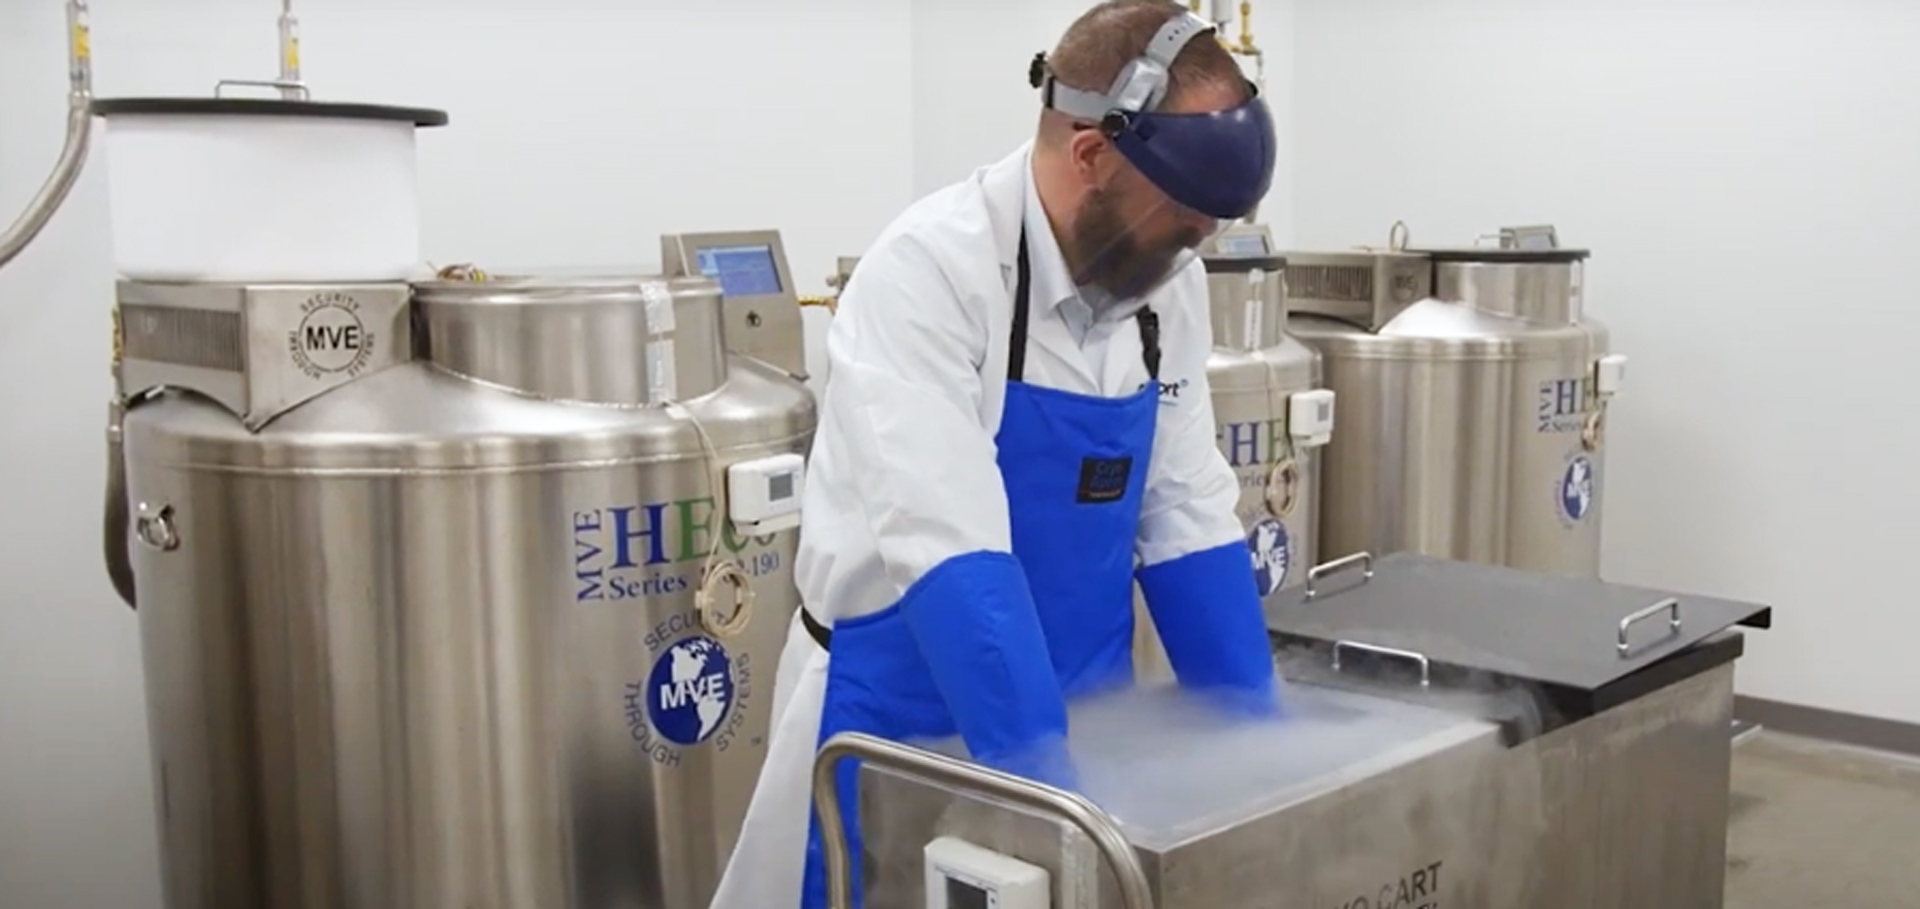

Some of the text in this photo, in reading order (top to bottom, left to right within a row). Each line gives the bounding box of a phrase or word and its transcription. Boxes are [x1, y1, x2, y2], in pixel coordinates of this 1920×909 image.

[306, 326, 359, 350] MVE
[1538, 379, 1552, 432] MVE
[574, 509, 604, 601] MVE
[1251, 546, 1285, 570] MVE
[609, 572, 688, 600] Series
[660, 673, 725, 710] MVE
[716, 652, 751, 752] SYSTEMS
[624, 680, 681, 767] THROUGH
[1377, 860, 1443, 909] CART
